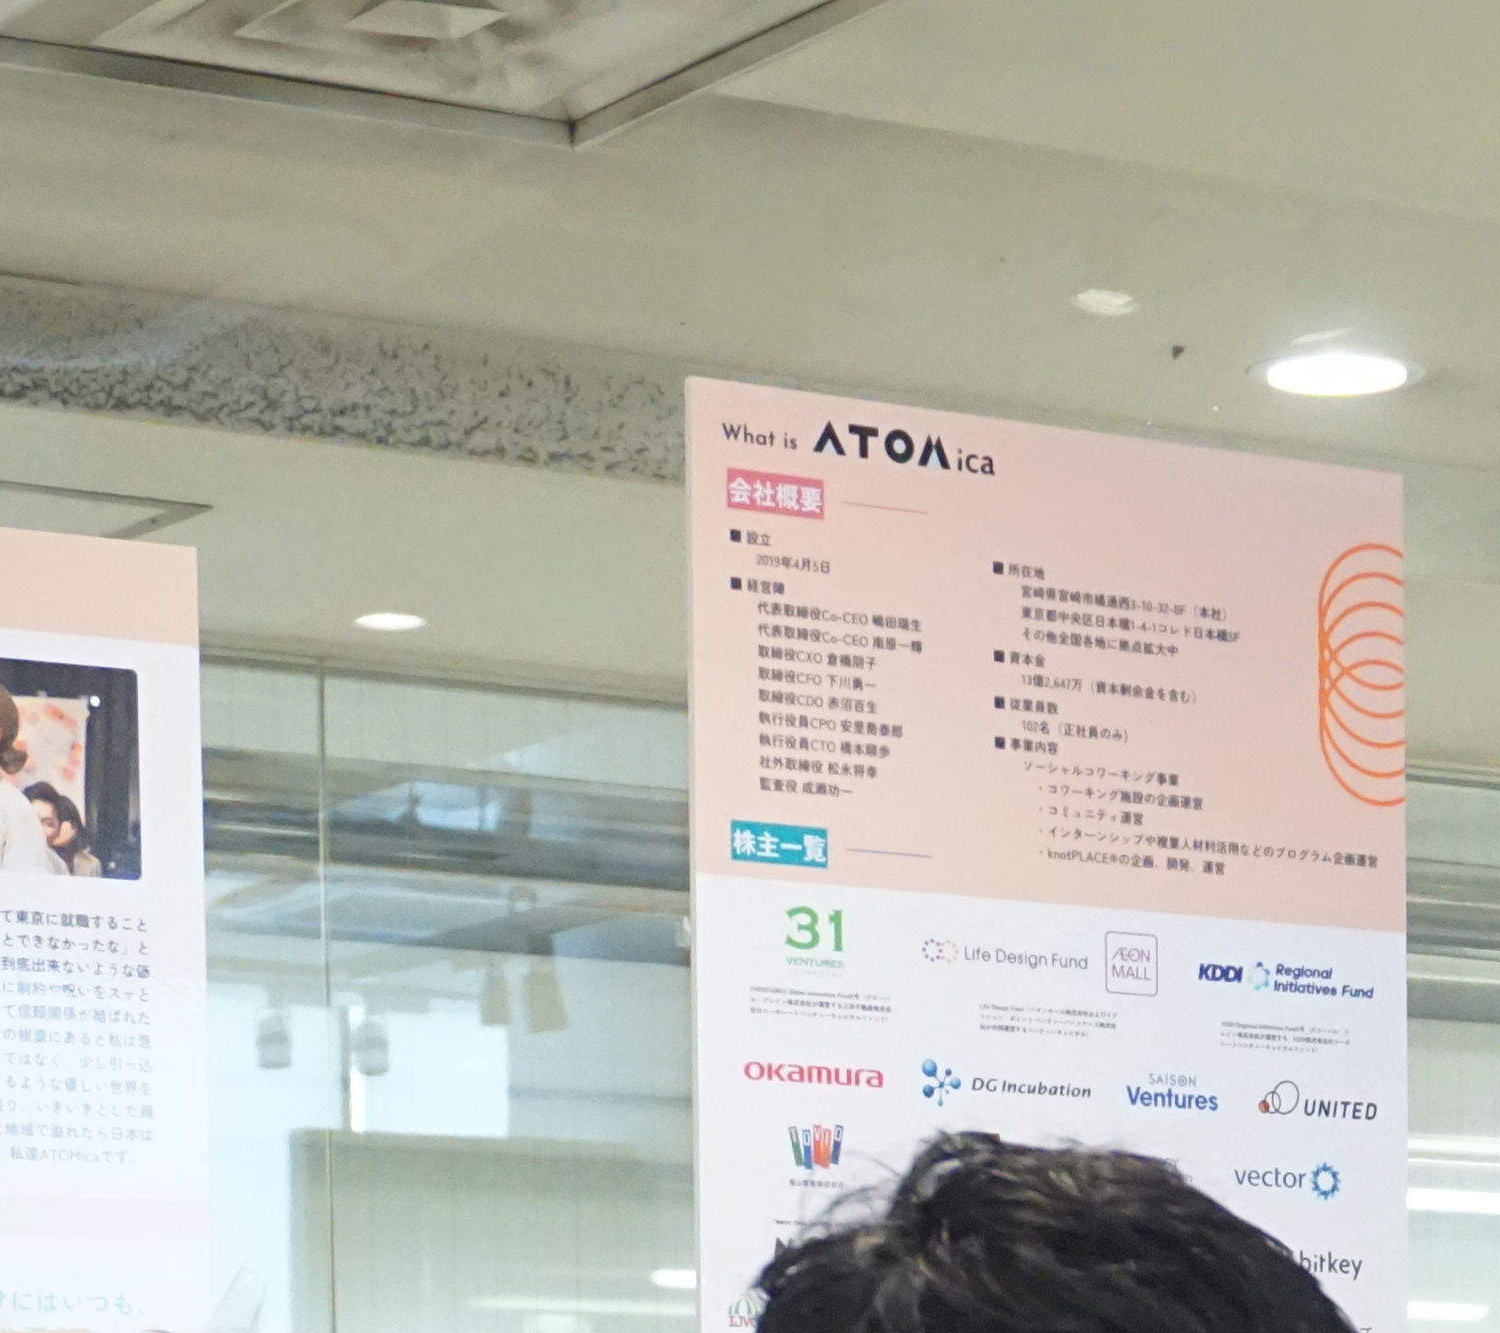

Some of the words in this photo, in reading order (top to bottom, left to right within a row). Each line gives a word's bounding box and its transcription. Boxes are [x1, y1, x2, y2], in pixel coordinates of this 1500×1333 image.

[722, 421, 776, 448] What
[782, 430, 798, 451] is
[728, 476, 822, 514] 会社概要
[746, 529, 770, 548] 設立
[755, 552, 830, 575] 2019年4月5日
[1007, 561, 1045, 581] 所在地
[1008, 649, 1046, 668] 資本金
[1009, 736, 1058, 757] 事業内容
[732, 827, 826, 864] 株主一覧
[785, 905, 845, 954] 31
[786, 955, 844, 971] VENTURES
[964, 943, 993, 965] Life
[995, 948, 1048, 971] Design
[1051, 951, 1089, 971] Fund
[1111, 962, 1152, 982] MALL
[1199, 962, 1243, 984] KDDI
[1275, 962, 1333, 982] Regional
[1274, 977, 1338, 996] Initiatives
[1341, 982, 1374, 1000] Fund
[971, 1075, 996, 1094] DG
[1001, 1077, 1092, 1099] Incubation
[1148, 1072, 1197, 1088] SAISON
[1126, 1085, 1218, 1112] Ventures
[1303, 1099, 1378, 1121] UNITED
[1234, 1166, 1307, 1189] vector
[1299, 1249, 1363, 1281] bitkey
